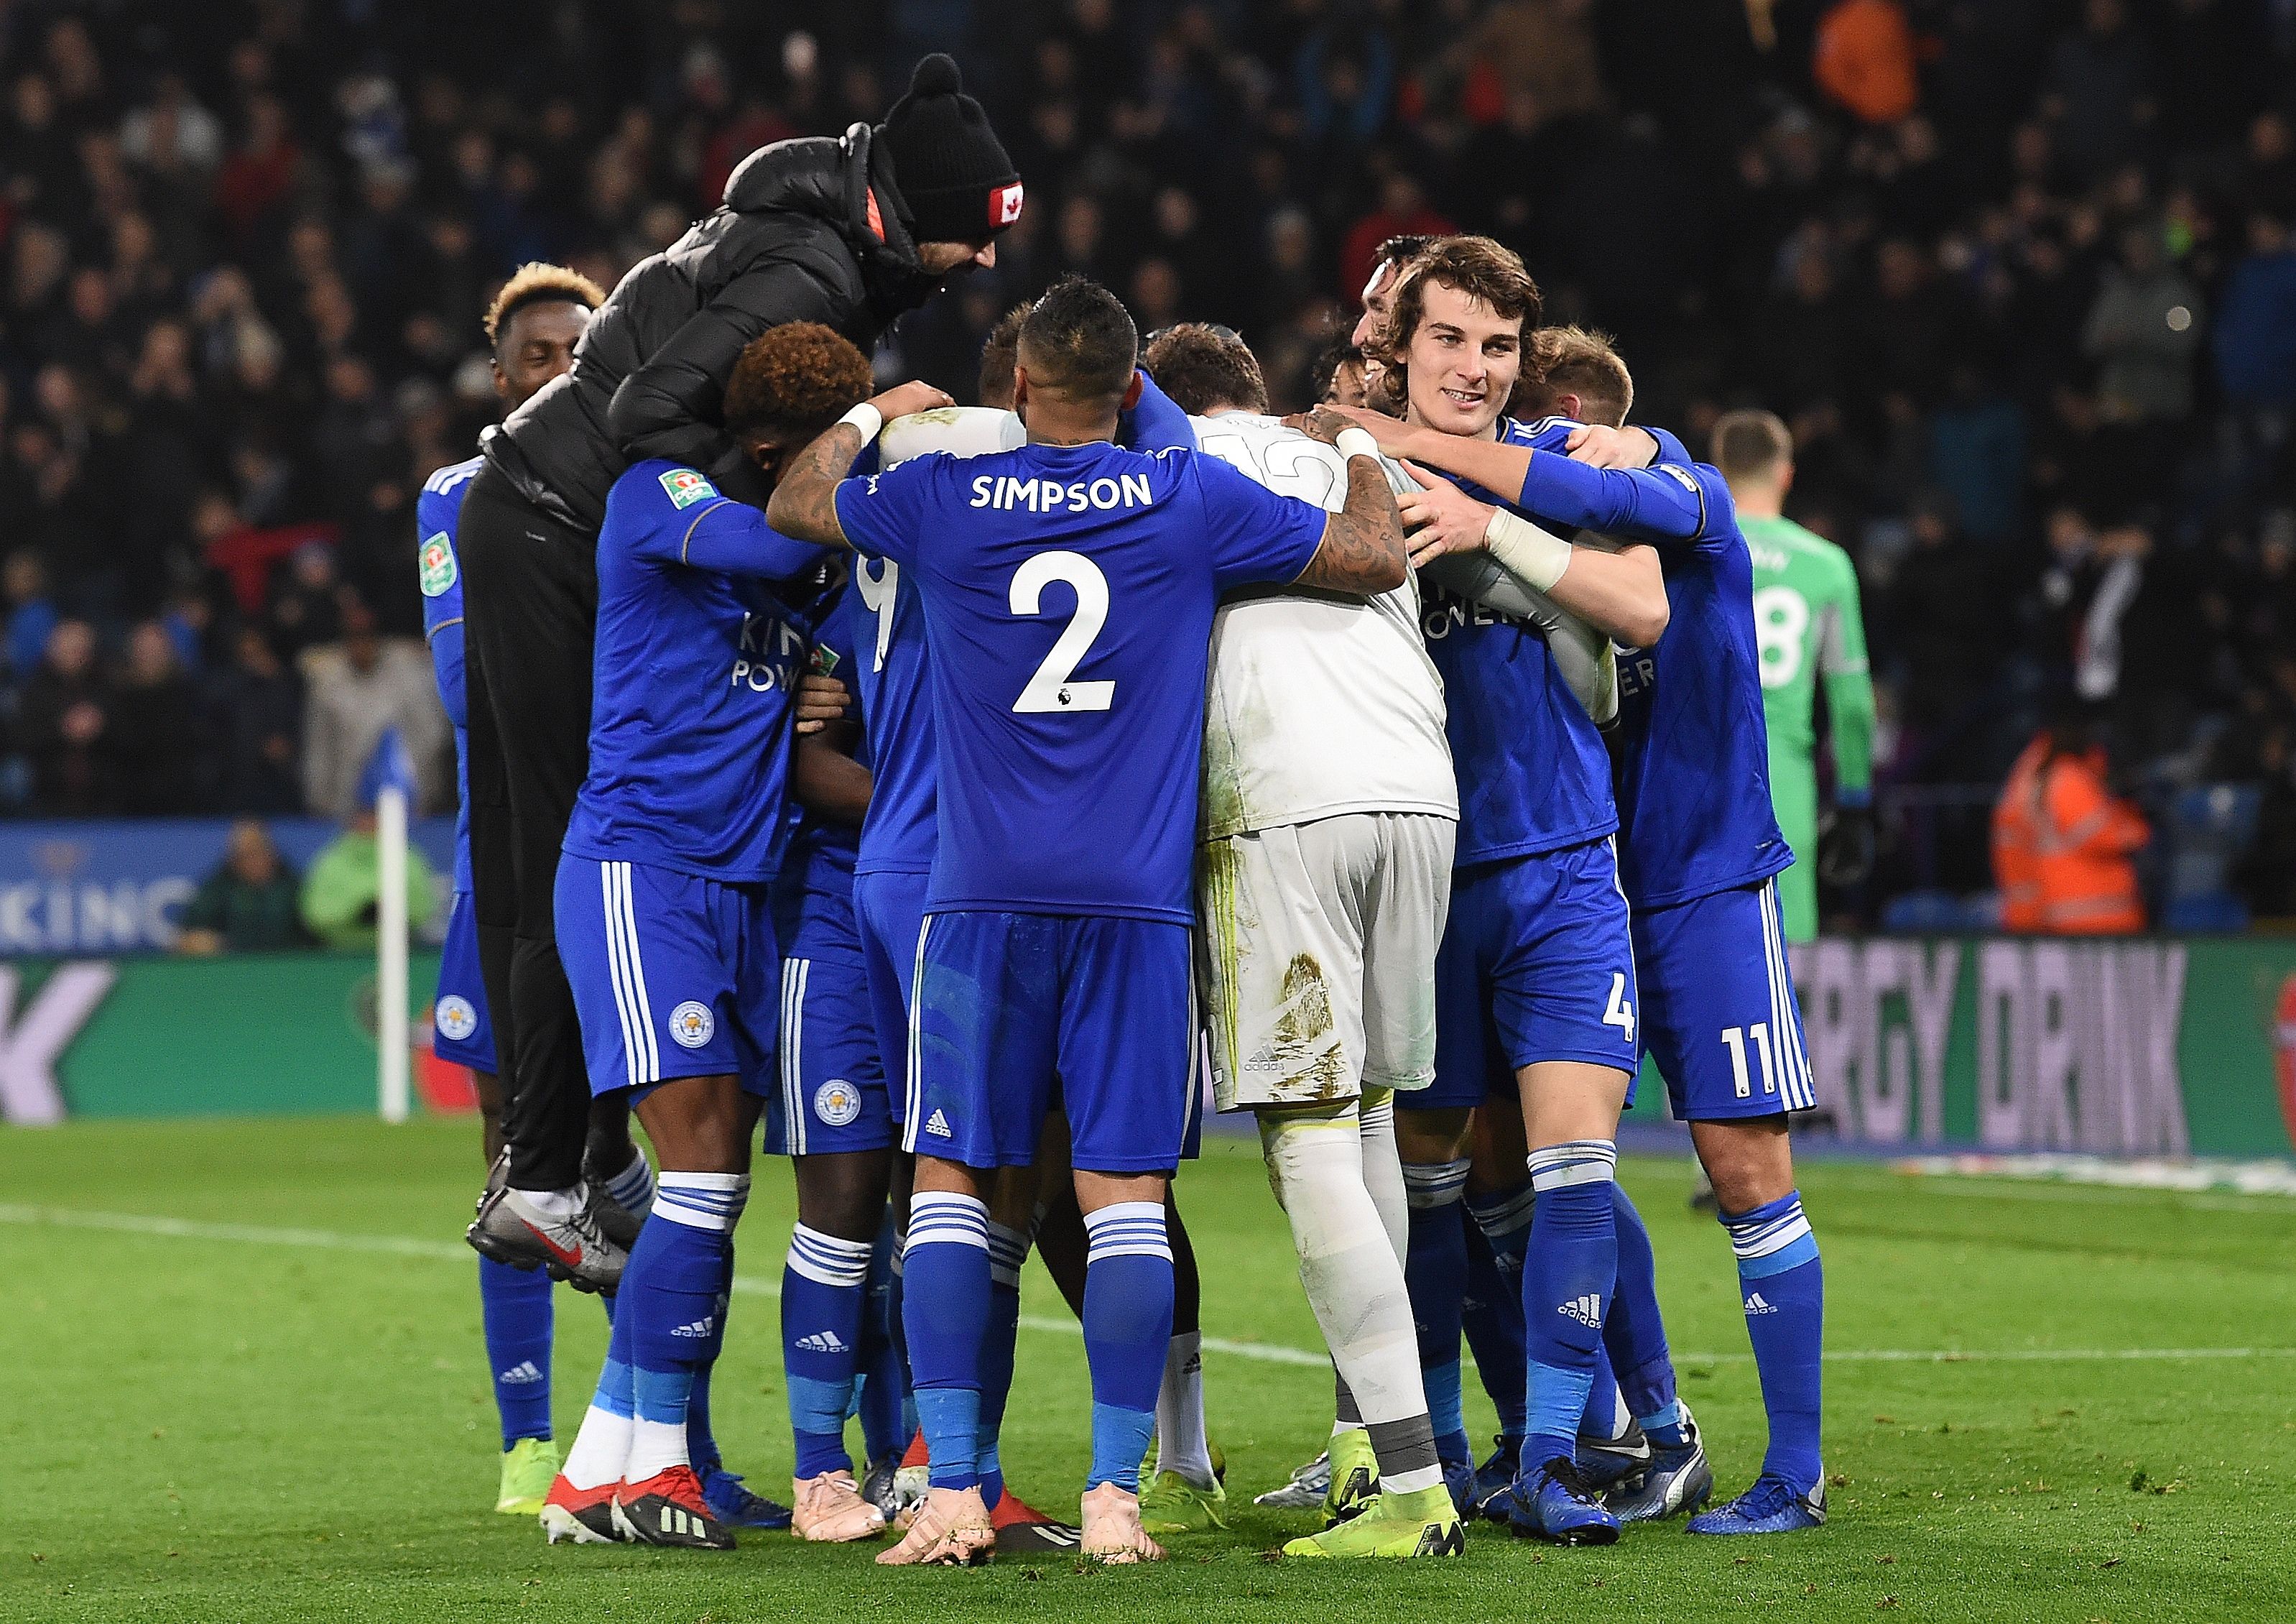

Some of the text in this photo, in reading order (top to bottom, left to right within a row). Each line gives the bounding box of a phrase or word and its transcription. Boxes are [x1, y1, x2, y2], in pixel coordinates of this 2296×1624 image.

[969, 474, 1153, 512] SIMPSON
[856, 554, 899, 673] 9
[1009, 550, 1116, 713] 2
[1602, 972, 1635, 1042] 4
[1244, 1061, 1285, 1071] adidas
[1721, 1023, 1775, 1098] 11
[1977, 940, 2190, 1155] DRINK
[795, 1341, 849, 1352] adidas
[1557, 1305, 1602, 1329] adidas
